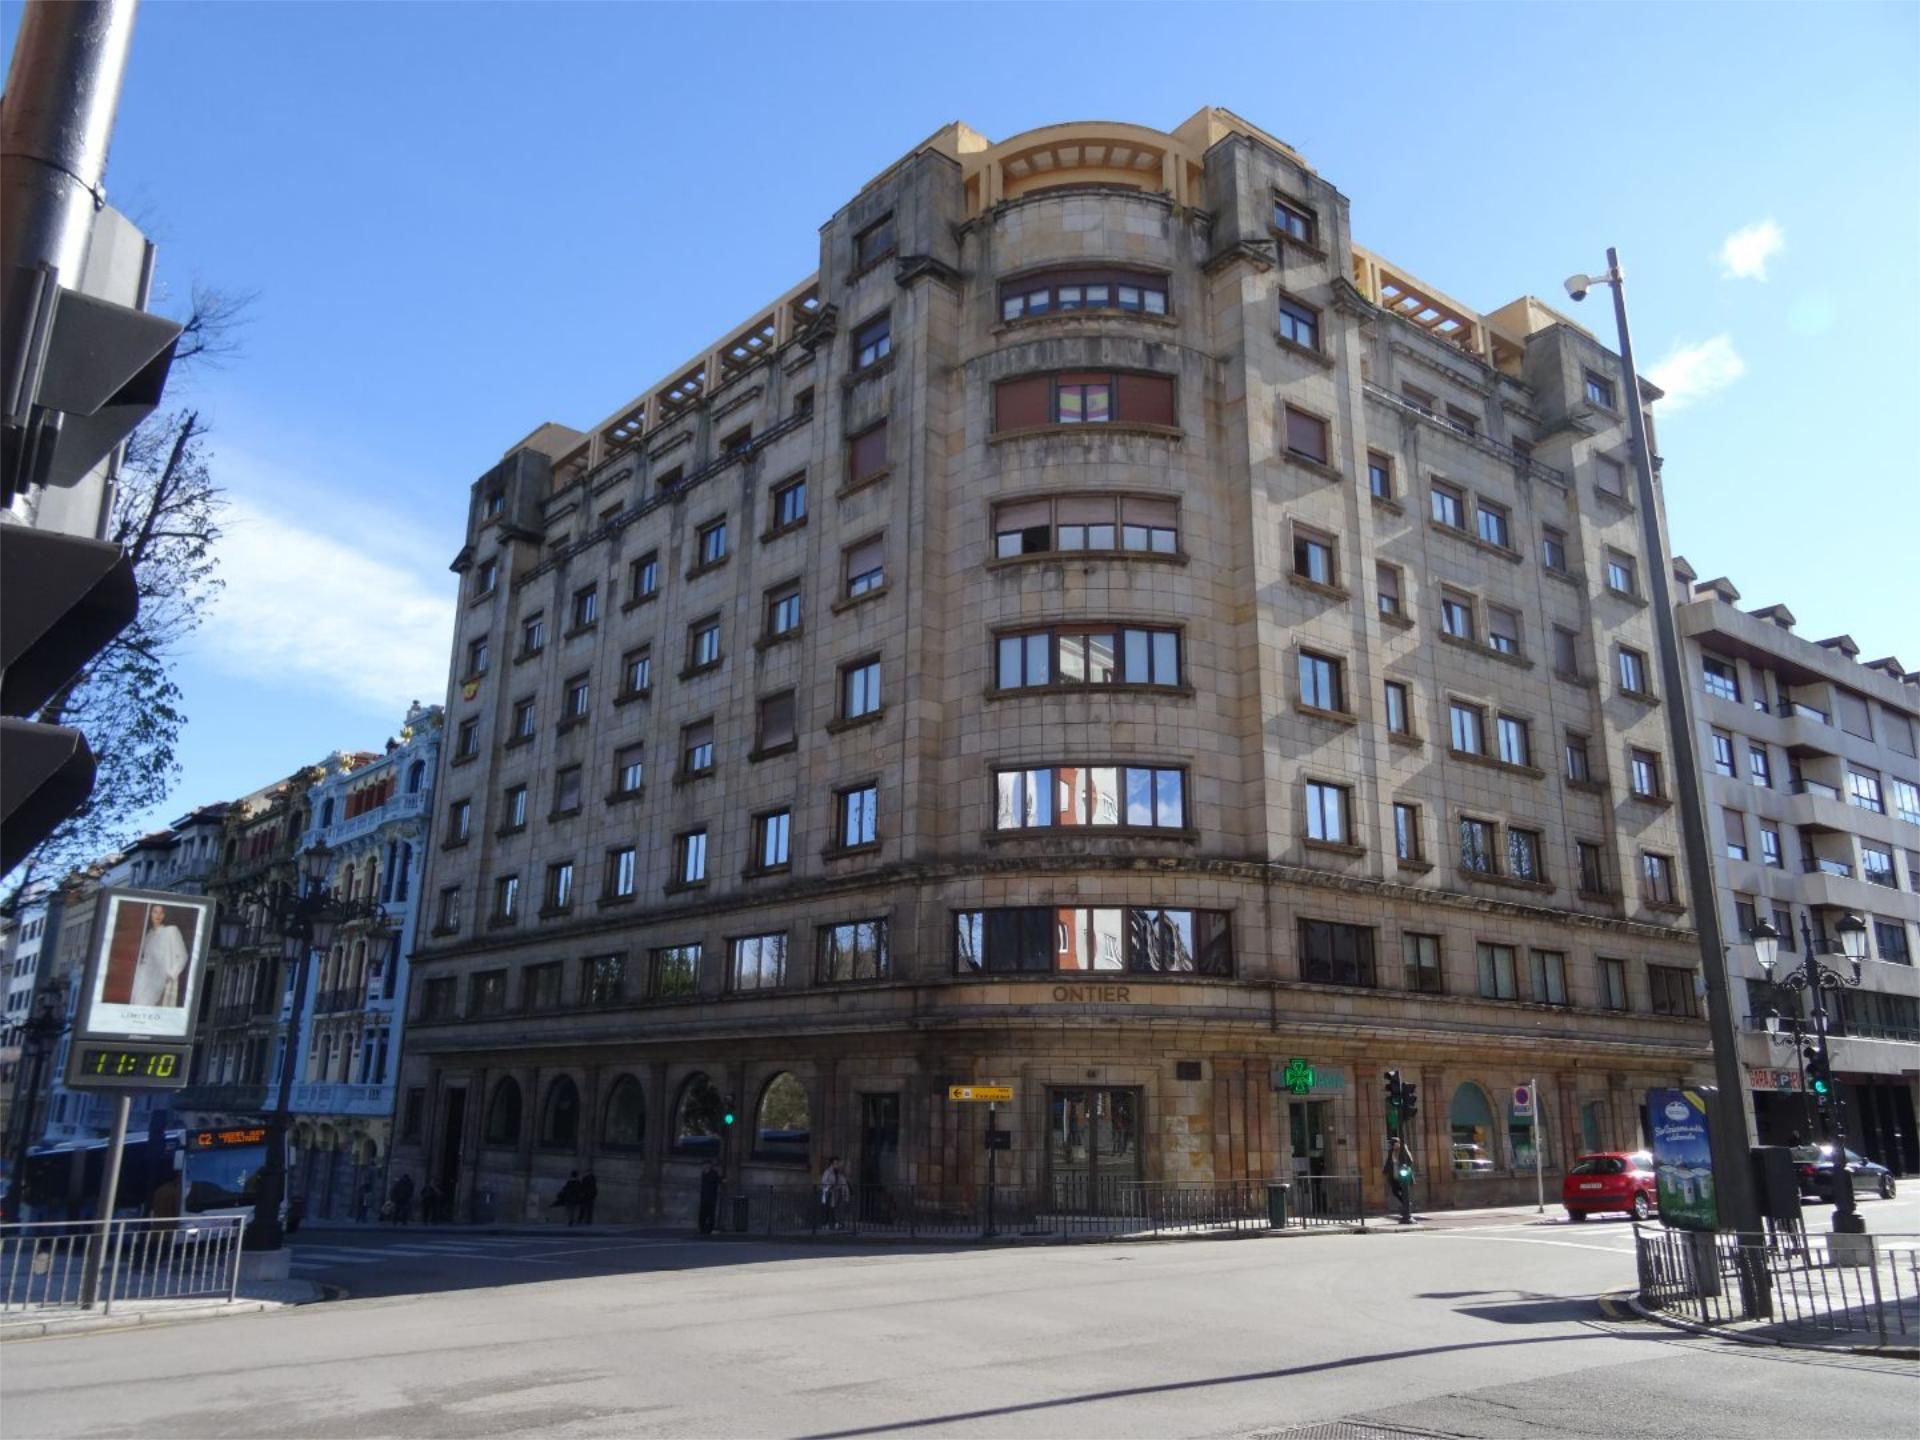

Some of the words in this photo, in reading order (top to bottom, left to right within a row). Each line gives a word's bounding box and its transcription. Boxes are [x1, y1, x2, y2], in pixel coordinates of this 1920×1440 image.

[1053, 986, 1131, 1002] ONTIER
[97, 1053, 176, 1077] 11:10
[198, 1132, 213, 1145] C2
